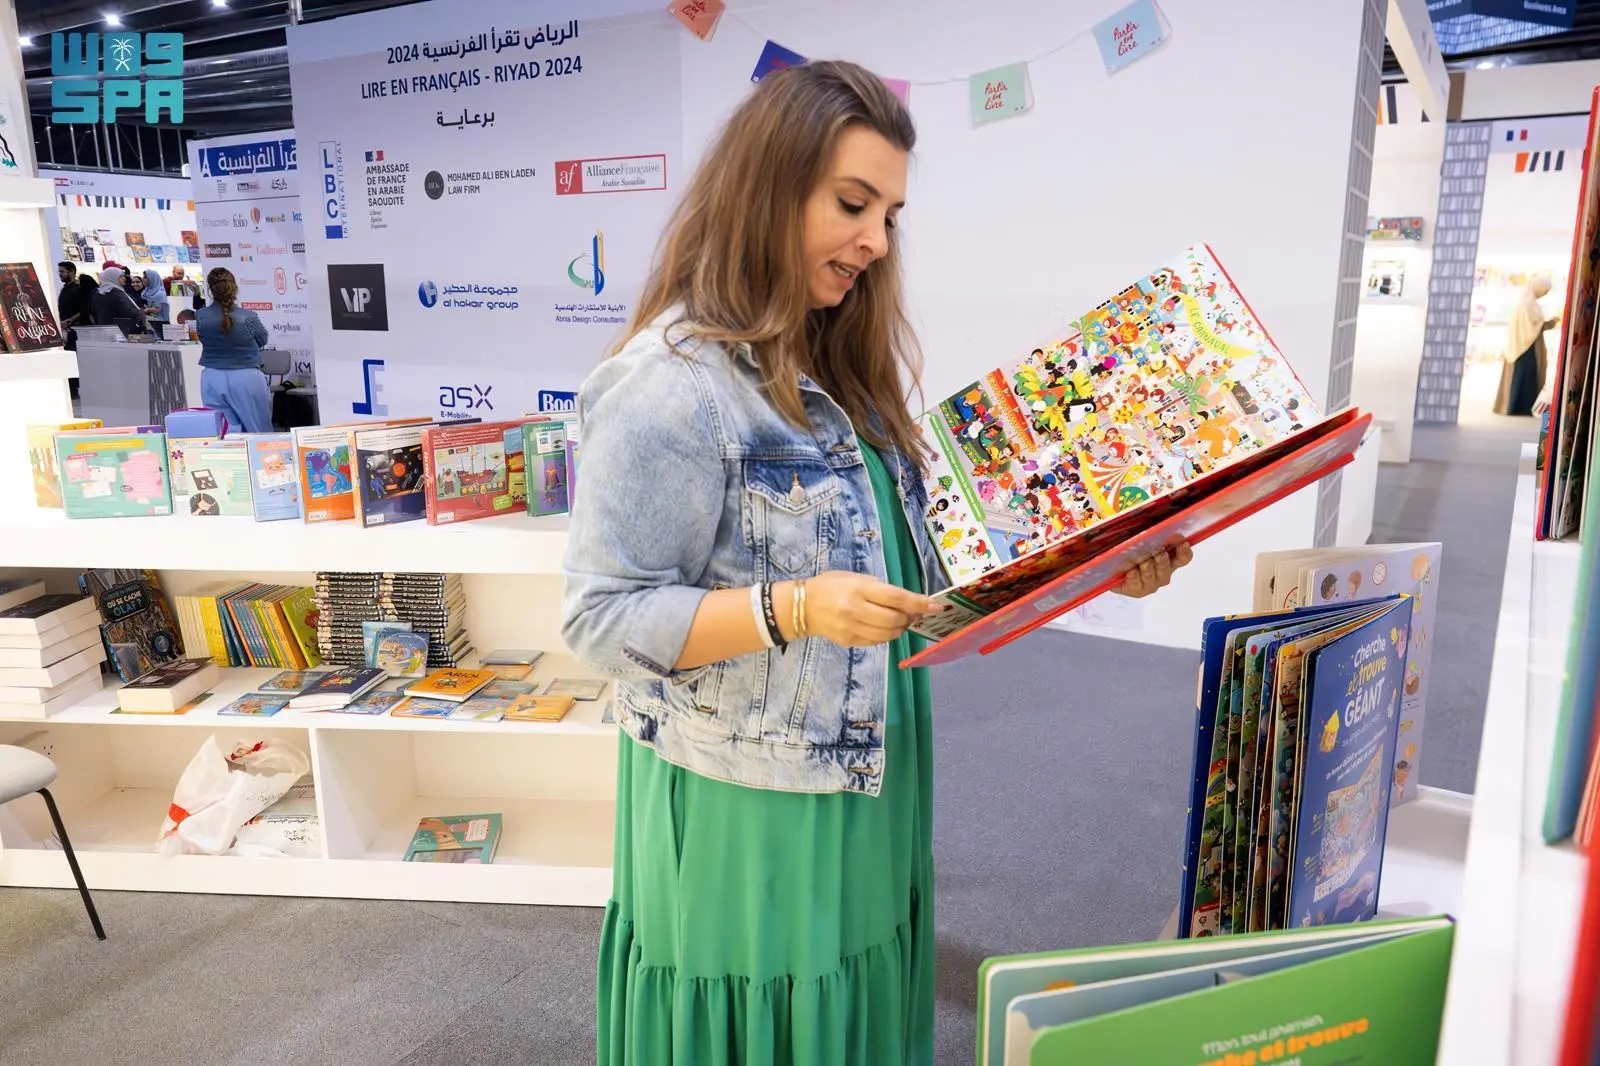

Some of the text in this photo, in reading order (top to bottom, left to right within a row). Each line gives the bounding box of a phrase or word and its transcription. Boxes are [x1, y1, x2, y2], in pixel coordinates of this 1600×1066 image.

[1524, 1, 1566, 14] Business Area
[387, 20, 578, 64] الرياض تقرأ الفرنسية 2024
[361, 81, 387, 98] LIRE
[391, 78, 408, 96] EN
[412, 69, 480, 93] FRANÇAIS
[494, 62, 540, 82] RIYAD
[545, 56, 582, 77] 2024
[218, 146, 276, 176] الفرنسية
[366, 163, 410, 174] AMBASSADE
[323, 148, 338, 218] LBC
[366, 174, 406, 186] DE FRANCE
[448, 168, 536, 182] MOHAMED ALI BEN LADEN
[560, 162, 578, 192] af
[336, 142, 348, 239] INTERNATIONAL
[368, 186, 404, 196] EN ARABIE
[368, 196, 404, 206] SAOUDITE
[448, 186, 462, 194] LAW
[464, 185, 480, 194] FIRM
[340, 288, 371, 312] VIP
[443, 284, 518, 296] مجموعة الحكير
[12, 306, 46, 322] REINE
[454, 300, 484, 308] hokair
[487, 301, 518, 310] group
[1190, 308, 1200, 318] LE
[572, 316, 592, 324] Design
[1194, 322, 1230, 354] CARNAVAL
[1354, 636, 1386, 668] Cherche
[1358, 655, 1387, 685] trouve
[1344, 677, 1386, 728] GÉANT
[1202, 1038, 1240, 1056] Mon
[1240, 1030, 1268, 1046] tout
[1259, 1039, 1284, 1062] et
[1286, 1017, 1370, 1054] trouve
